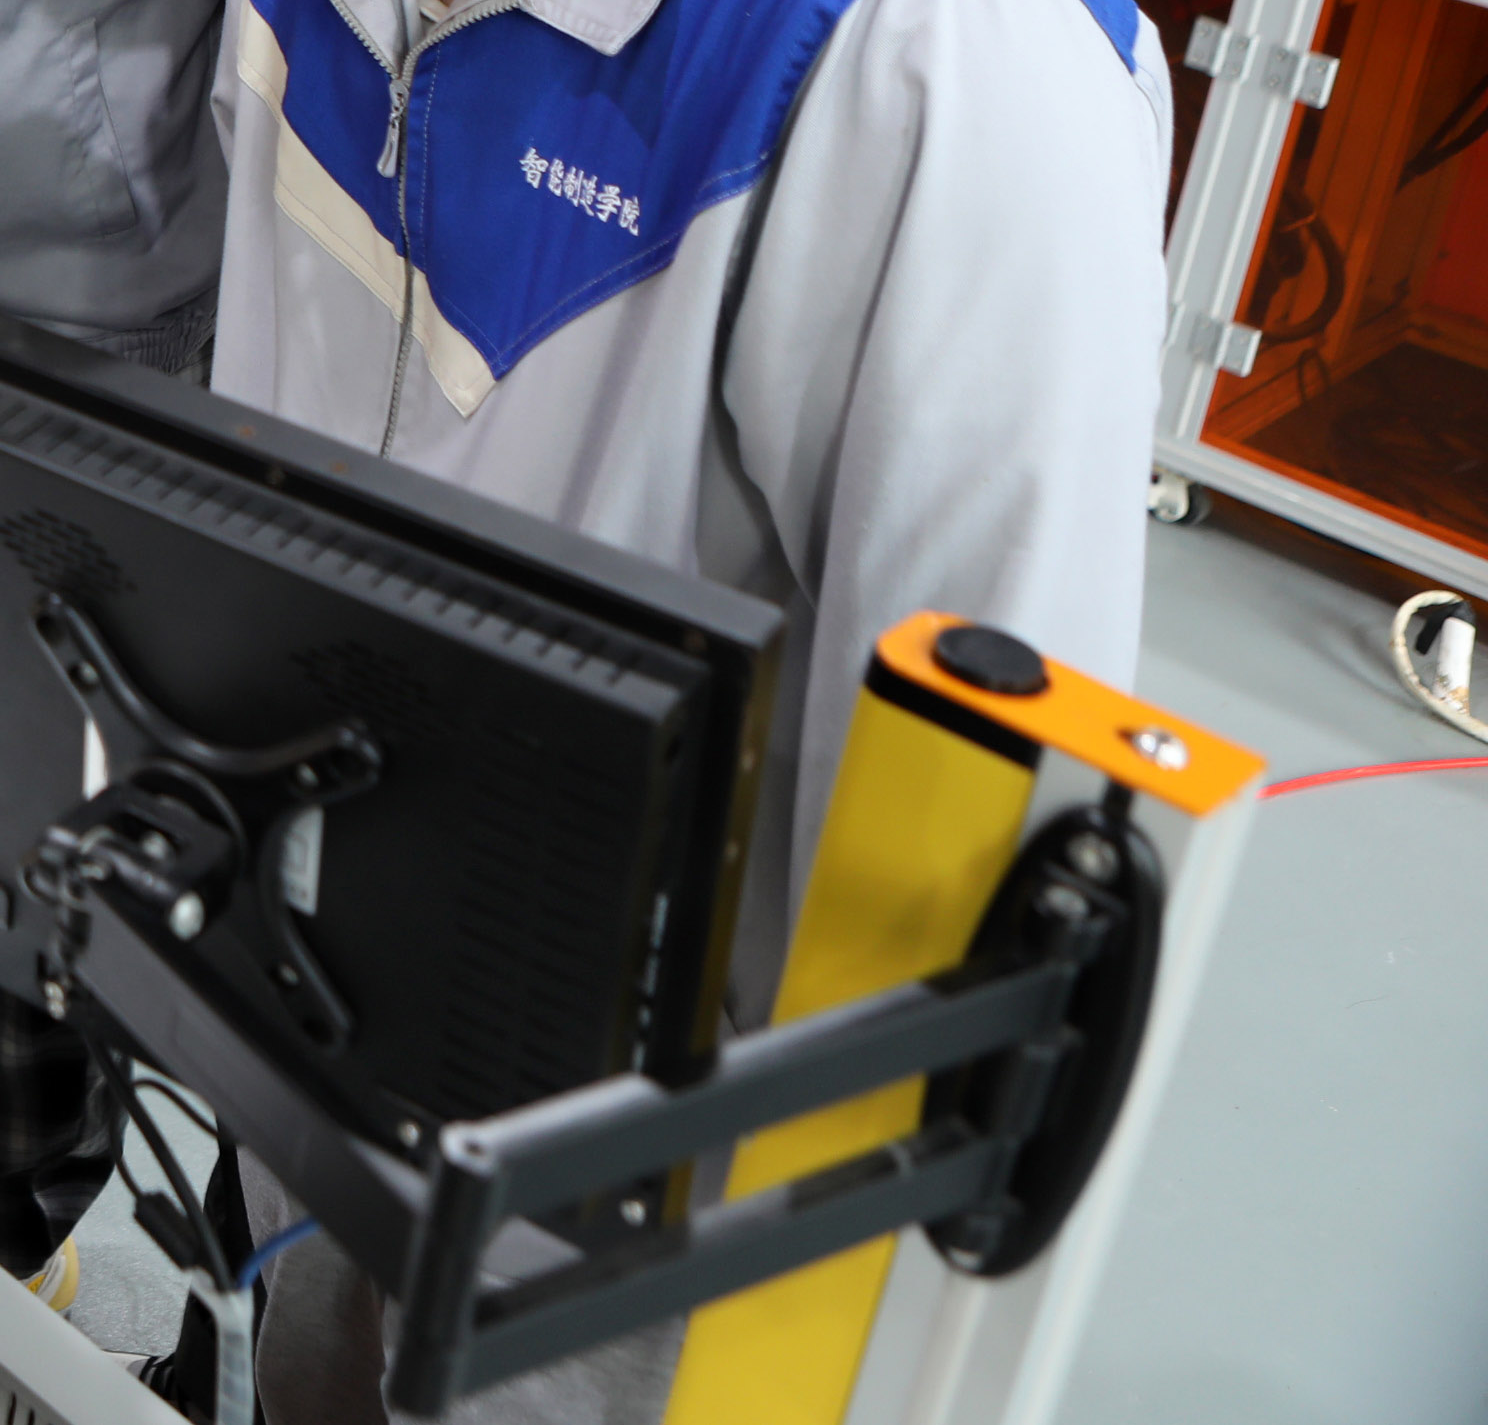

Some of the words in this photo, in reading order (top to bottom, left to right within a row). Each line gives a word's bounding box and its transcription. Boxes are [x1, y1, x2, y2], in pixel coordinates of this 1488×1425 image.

[519, 146, 640, 236] 智能制造学院
